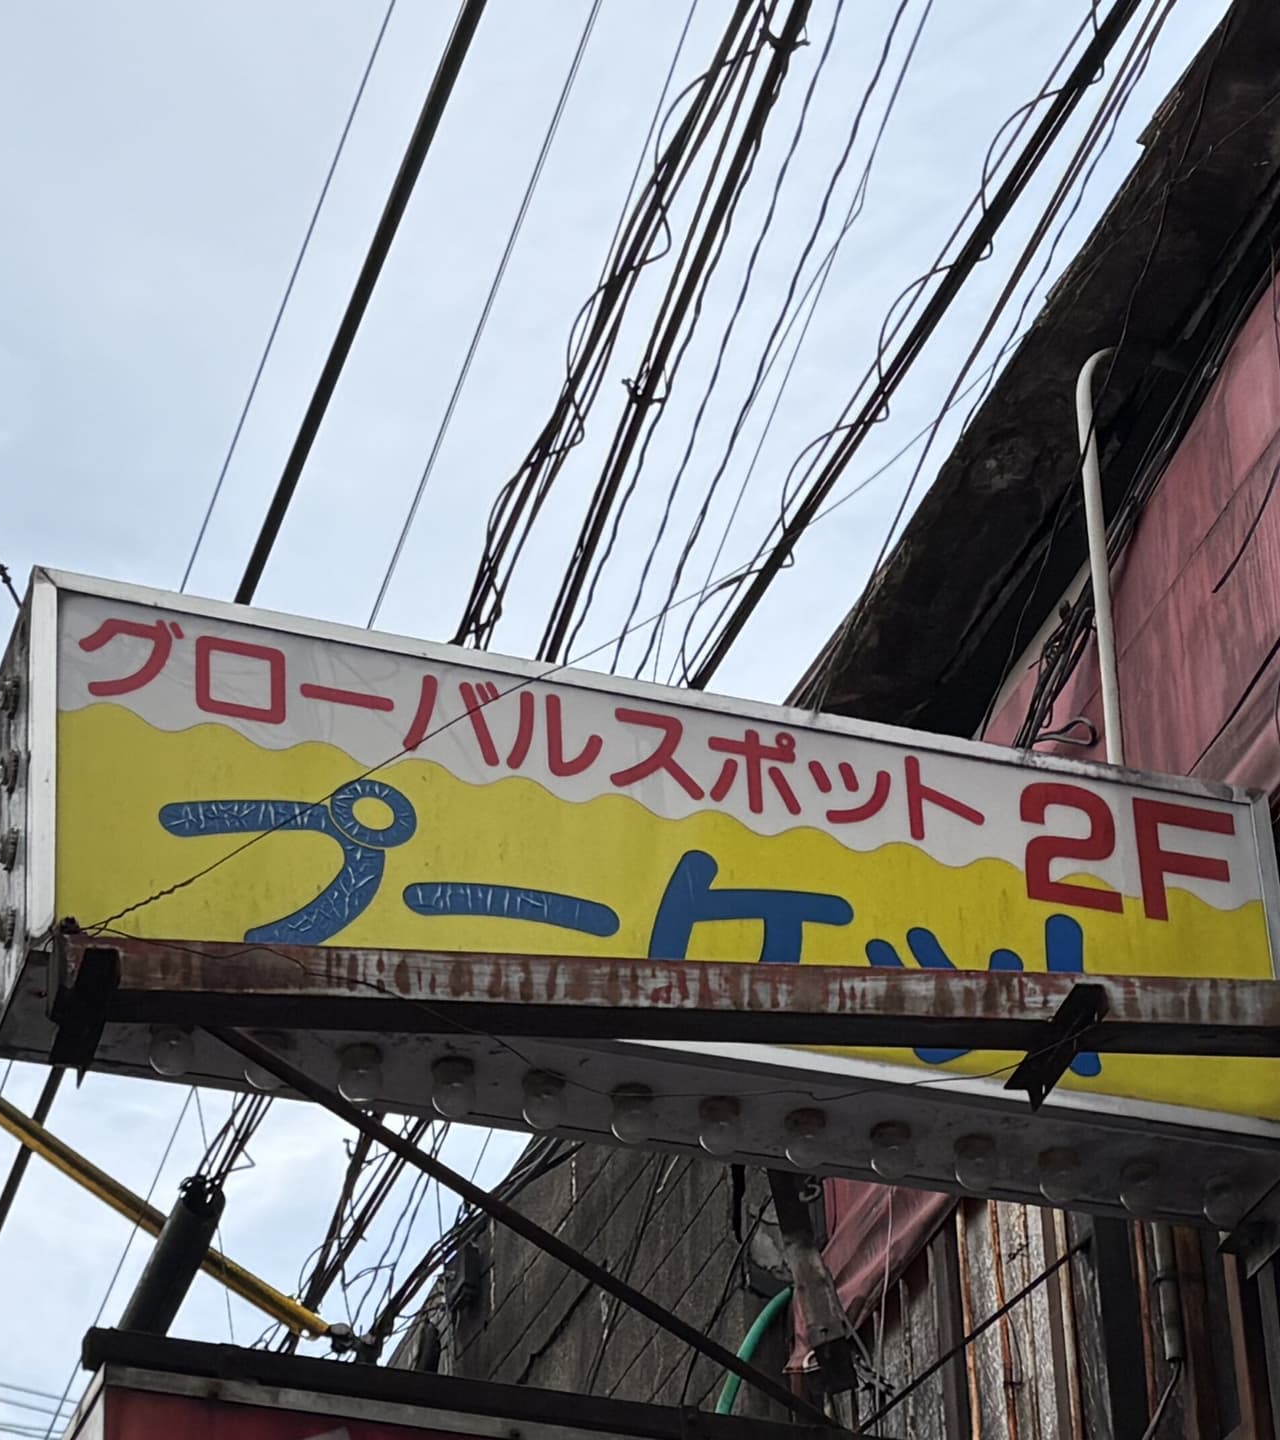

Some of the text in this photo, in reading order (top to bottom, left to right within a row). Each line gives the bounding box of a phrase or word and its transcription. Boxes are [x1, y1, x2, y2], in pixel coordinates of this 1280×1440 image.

[79, 617, 1236, 921] グローバルスポット 2F
